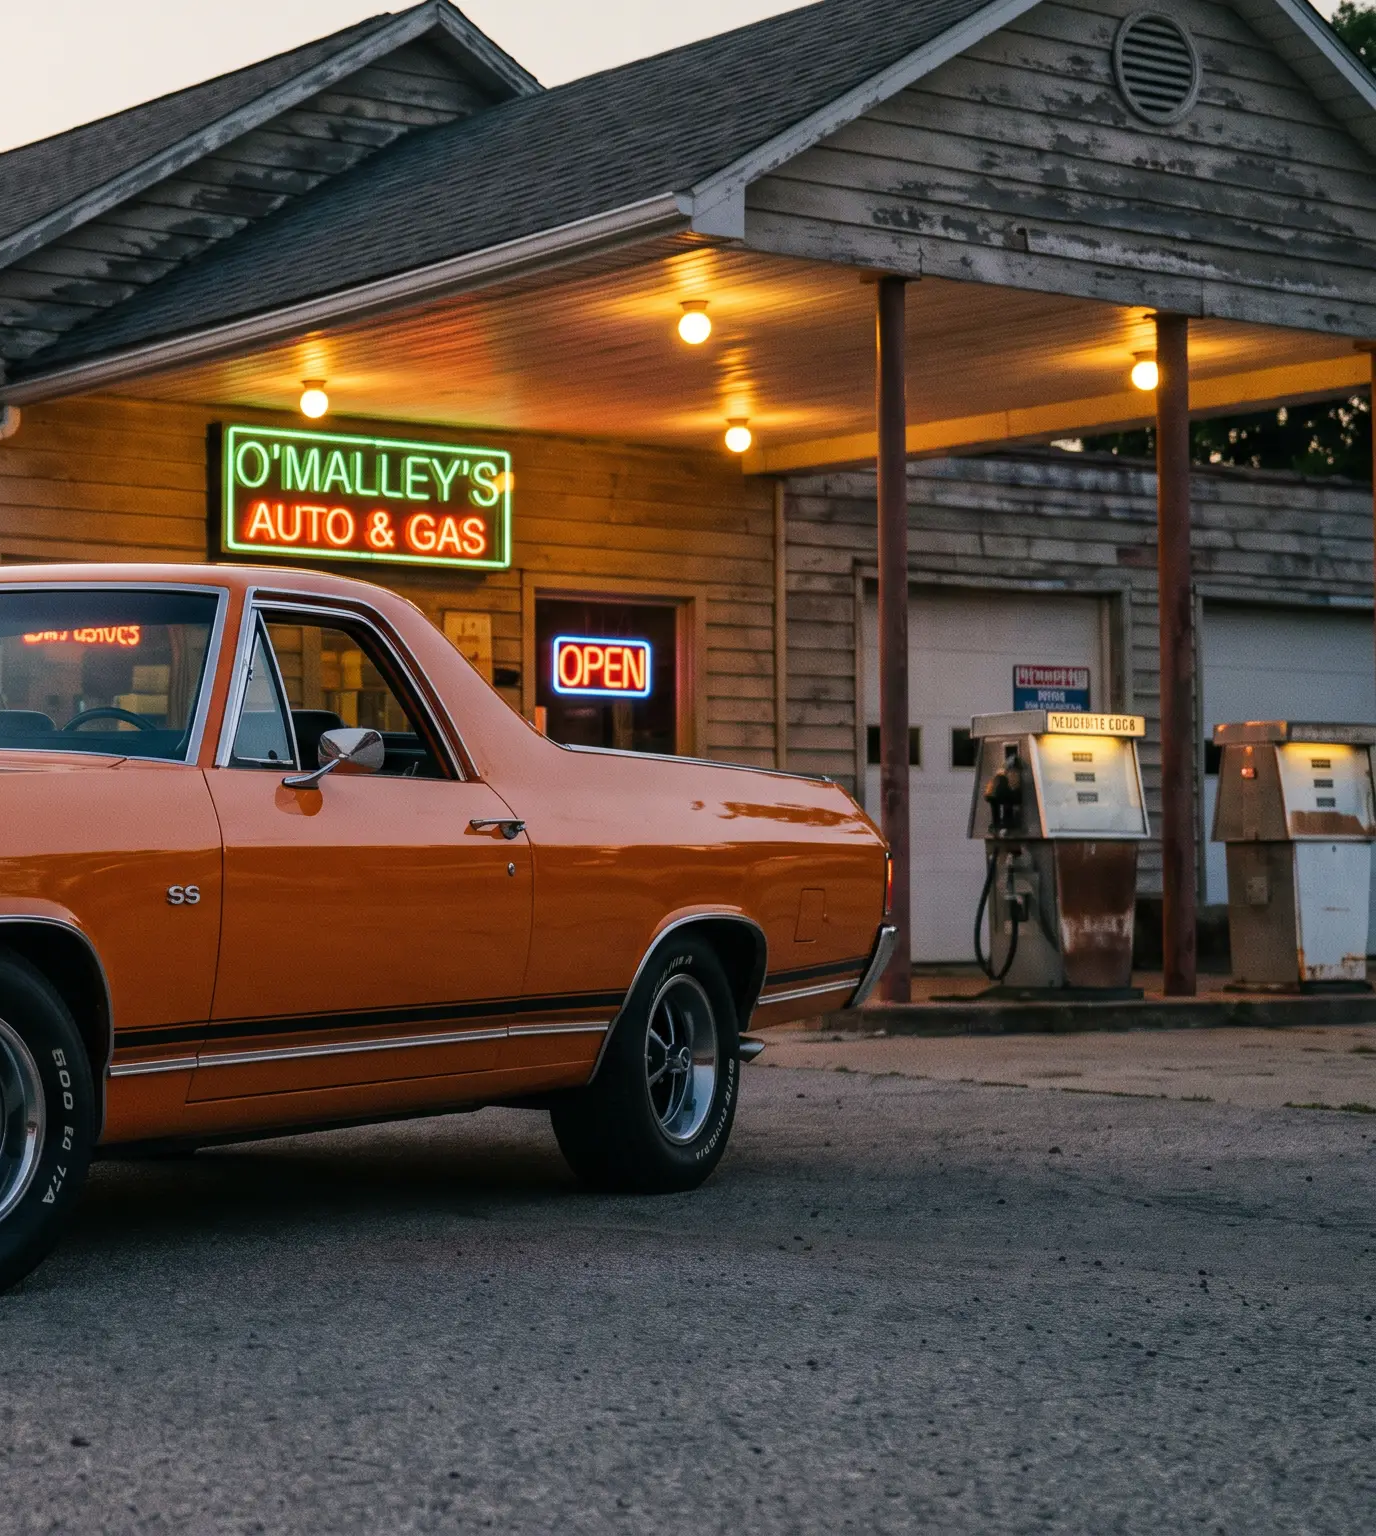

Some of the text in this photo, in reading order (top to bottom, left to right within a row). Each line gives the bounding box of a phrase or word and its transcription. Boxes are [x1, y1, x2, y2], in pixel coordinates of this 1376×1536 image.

[235, 440, 499, 507] O'MALLEY'S
[247, 502, 487, 555] AUTO & GAS
[559, 644, 645, 690] OPEN
[168, 885, 201, 905] SS
